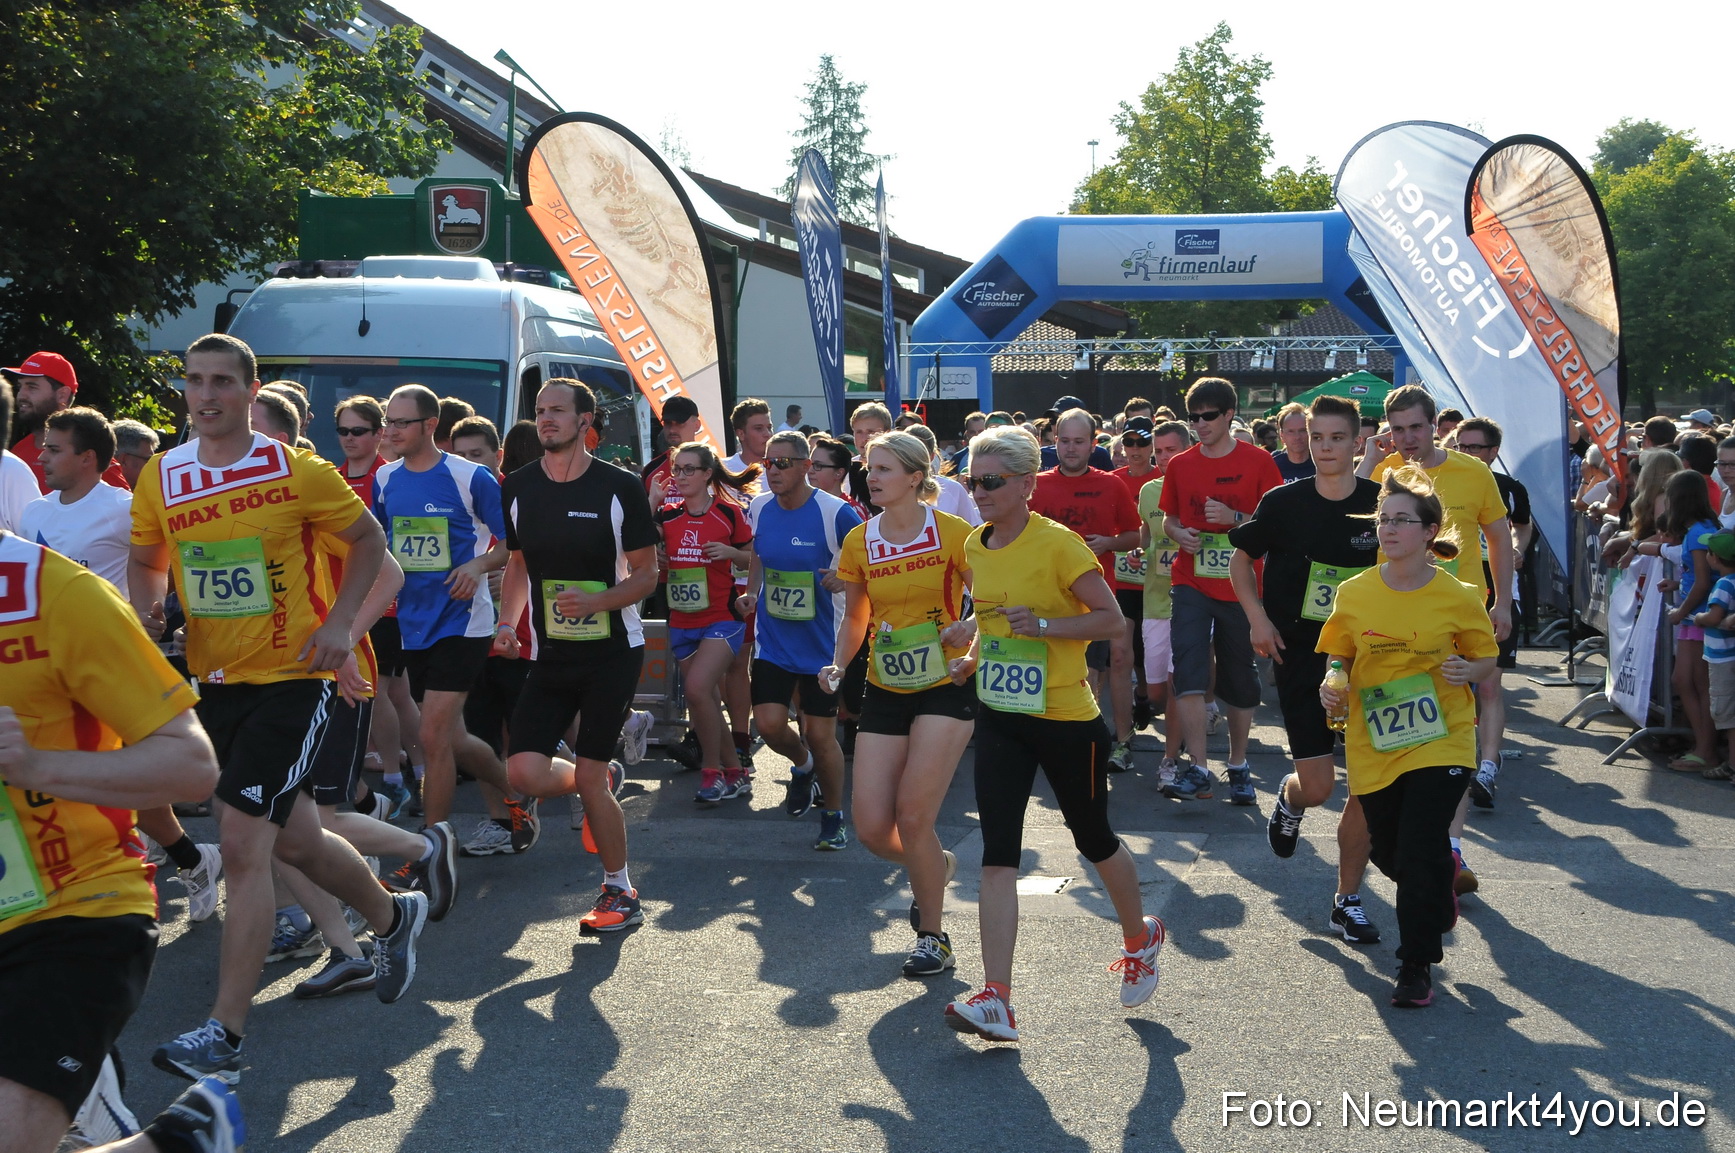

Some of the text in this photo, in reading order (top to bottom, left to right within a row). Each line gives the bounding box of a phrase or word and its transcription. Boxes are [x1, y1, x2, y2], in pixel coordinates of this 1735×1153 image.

[448, 239, 472, 248] 1628
[1159, 255, 1258, 273] firmenlauf
[973, 291, 1025, 301] Fischer
[167, 486, 298, 534] MAX BÖGL
[401, 536, 441, 557] 473
[677, 548, 702, 556] MEYER
[869, 555, 945, 579] MAX BÖGL
[1118, 557, 1147, 576] 39
[1160, 551, 1178, 567] 44
[1196, 549, 1235, 567] 135
[191, 567, 254, 600] 756
[671, 584, 700, 602] 856
[771, 587, 805, 608] 472
[0, 635, 50, 664] GL
[1414, 648, 1441, 656] Neumarkt
[882, 647, 930, 676] 807
[979, 661, 1042, 695] 1289
[1368, 697, 1437, 736] 1270
[241, 790, 263, 804] adidas
